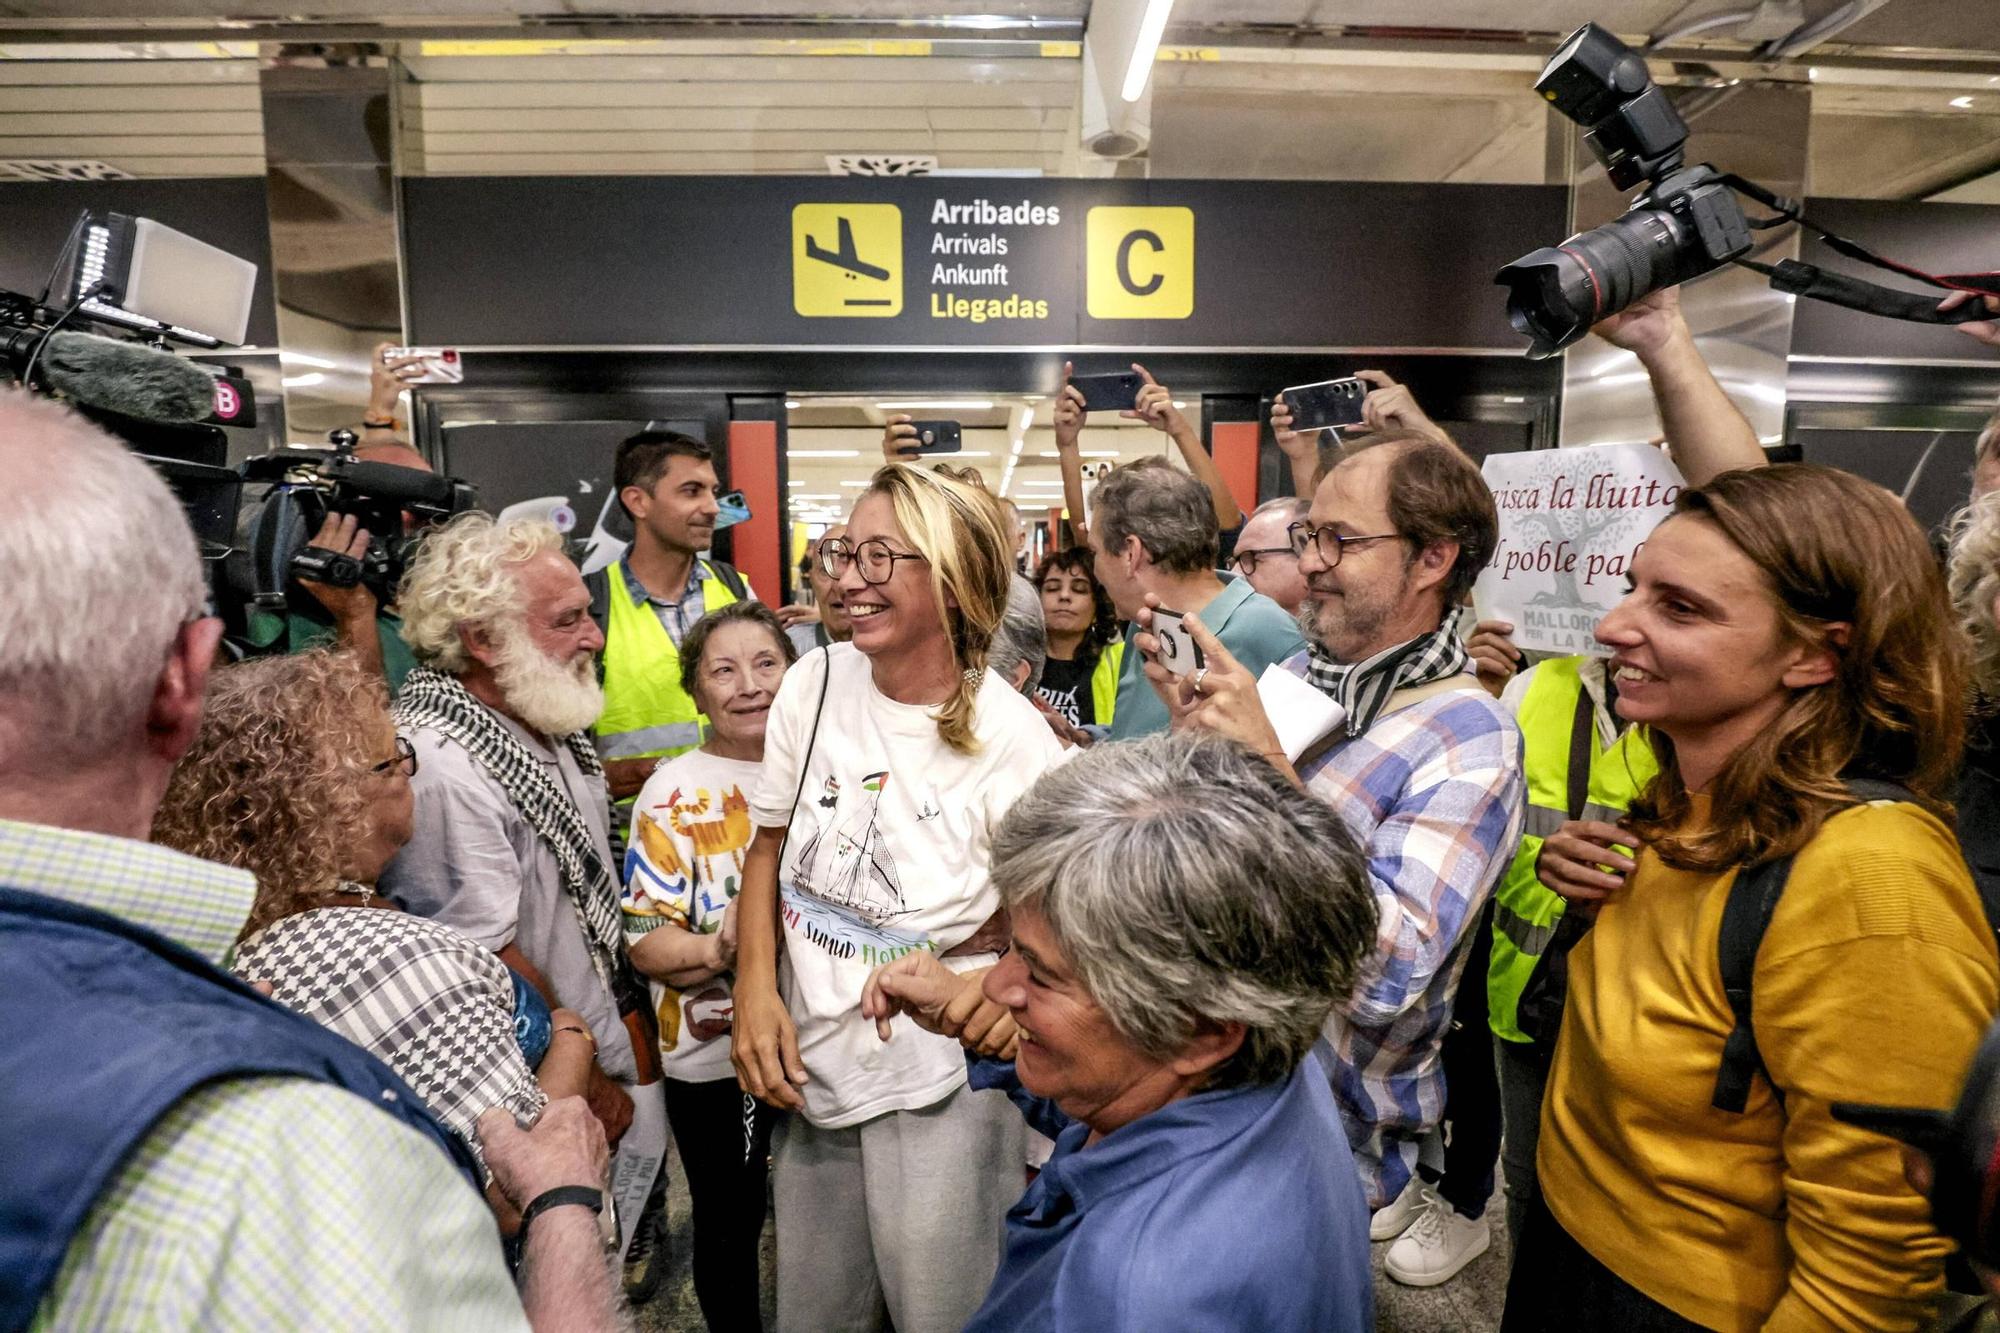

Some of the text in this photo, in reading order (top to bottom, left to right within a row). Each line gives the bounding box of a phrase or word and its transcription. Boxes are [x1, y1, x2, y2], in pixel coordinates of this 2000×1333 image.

[931, 199, 1060, 225] Arribades
[931, 232, 1008, 255] Arrivals
[931, 263, 1008, 285] Ankunft
[1116, 229, 1165, 296] C
[931, 293, 1048, 323] Llegadas
[216, 387, 235, 413] B
[1550, 476, 1575, 509] la
[1502, 540, 1576, 580] poble
[1553, 633, 1575, 648] LA
[803, 921, 855, 959] SUMUD
